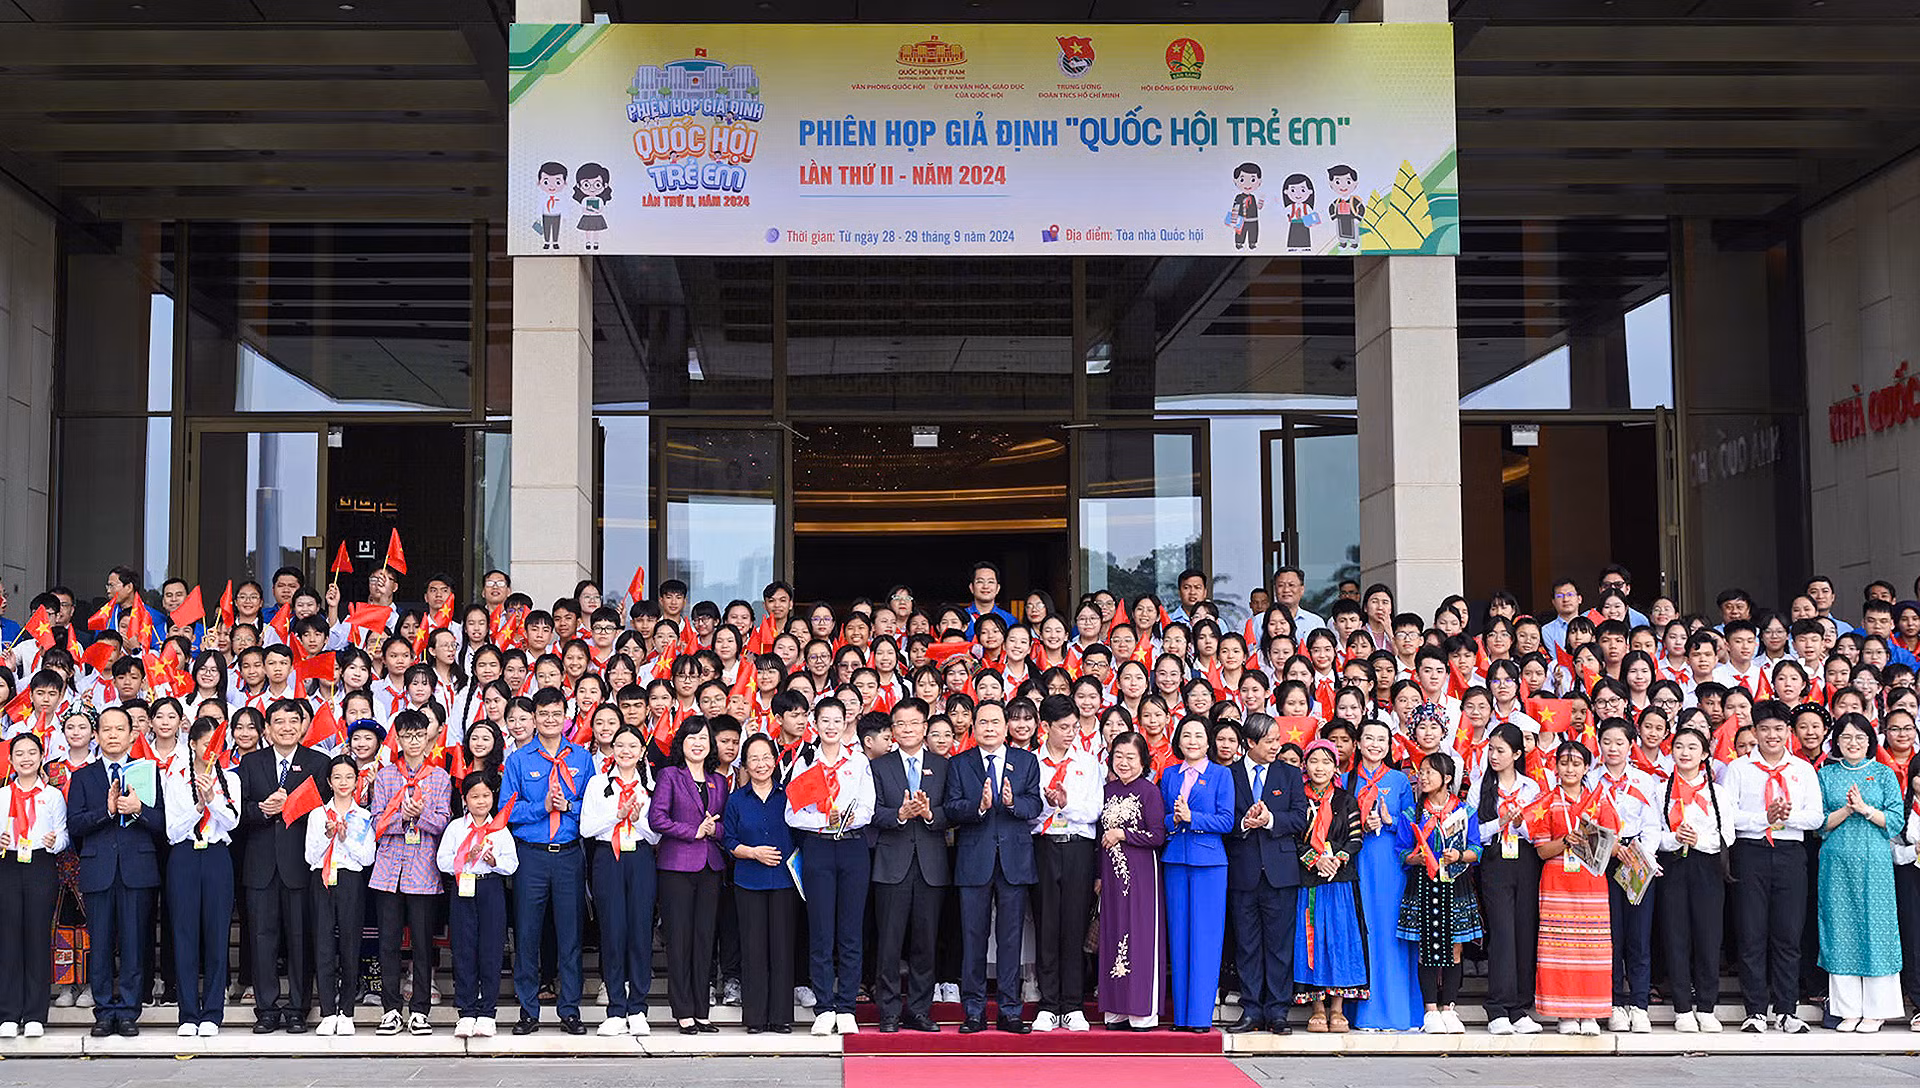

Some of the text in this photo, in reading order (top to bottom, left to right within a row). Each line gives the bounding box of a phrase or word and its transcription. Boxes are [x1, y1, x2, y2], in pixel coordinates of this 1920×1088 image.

[634, 116, 759, 164] QUỐC HỘI
[800, 105, 1350, 152] PHIÊN HỌP GIẢ ĐỊNH "QUỐC HỘI TRẺ EM"
[648, 157, 746, 192] TRẺ EM
[800, 159, 832, 185] LẦN
[838, 163, 876, 185] THỨ
[881, 166, 893, 185] II
[912, 162, 952, 185] NĂM
[959, 165, 1006, 185] 2024
[723, 195, 750, 207] 2024
[787, 229, 807, 242] Thời
[811, 230, 835, 245] gian:
[854, 231, 879, 245] ngày
[882, 230, 895, 243] 28
[905, 230, 918, 243] 29
[921, 230, 950, 245] tháng
[953, 230, 960, 243] 9
[964, 230, 986, 243] năm
[989, 230, 1015, 243] 2024
[1066, 226, 1204, 243] Địa điểm: Tòa nhà Quốc hội
[1829, 360, 1920, 444] NHÀ QUỐC
